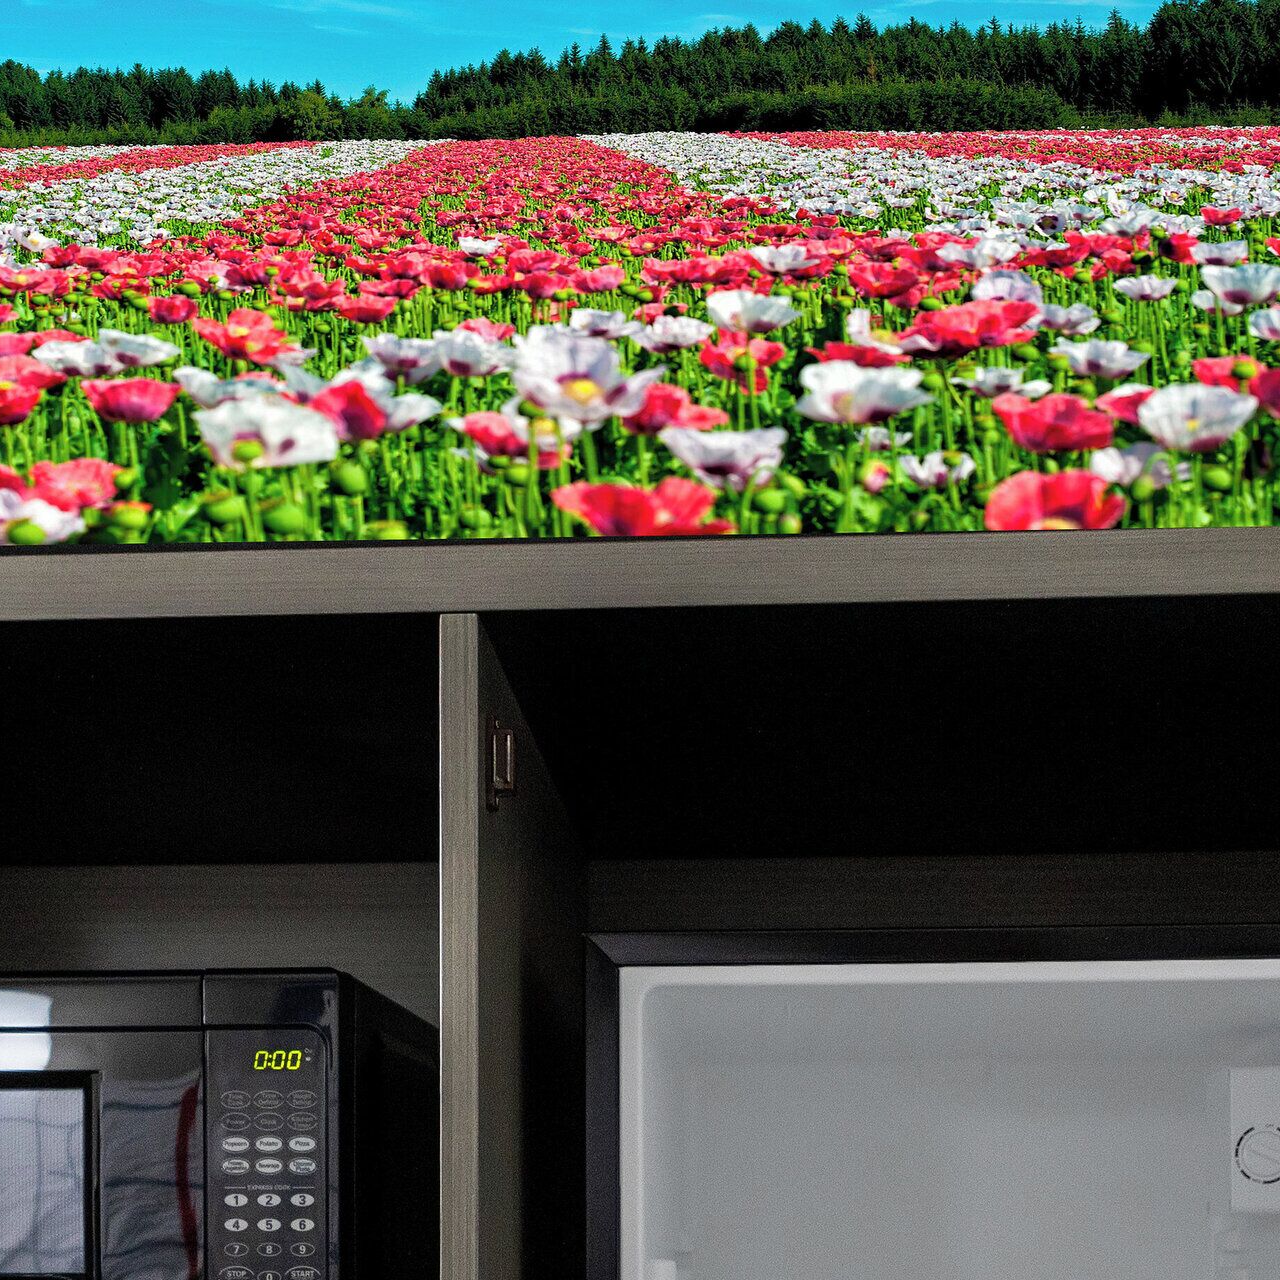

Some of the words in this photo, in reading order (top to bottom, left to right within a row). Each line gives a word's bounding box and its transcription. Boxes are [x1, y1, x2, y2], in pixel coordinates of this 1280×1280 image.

[254, 1050, 302, 1070] 0:00
[233, 1195, 239, 1205] 1
[265, 1195, 273, 1205] 2
[298, 1195, 306, 1205] 3
[232, 1220, 240, 1230] 4
[265, 1220, 273, 1230] 5
[299, 1220, 306, 1230] 6
[233, 1245, 240, 1254] 7
[266, 1245, 273, 1254] 8
[299, 1245, 306, 1254] 9
[226, 1270, 247, 1278] STOP
